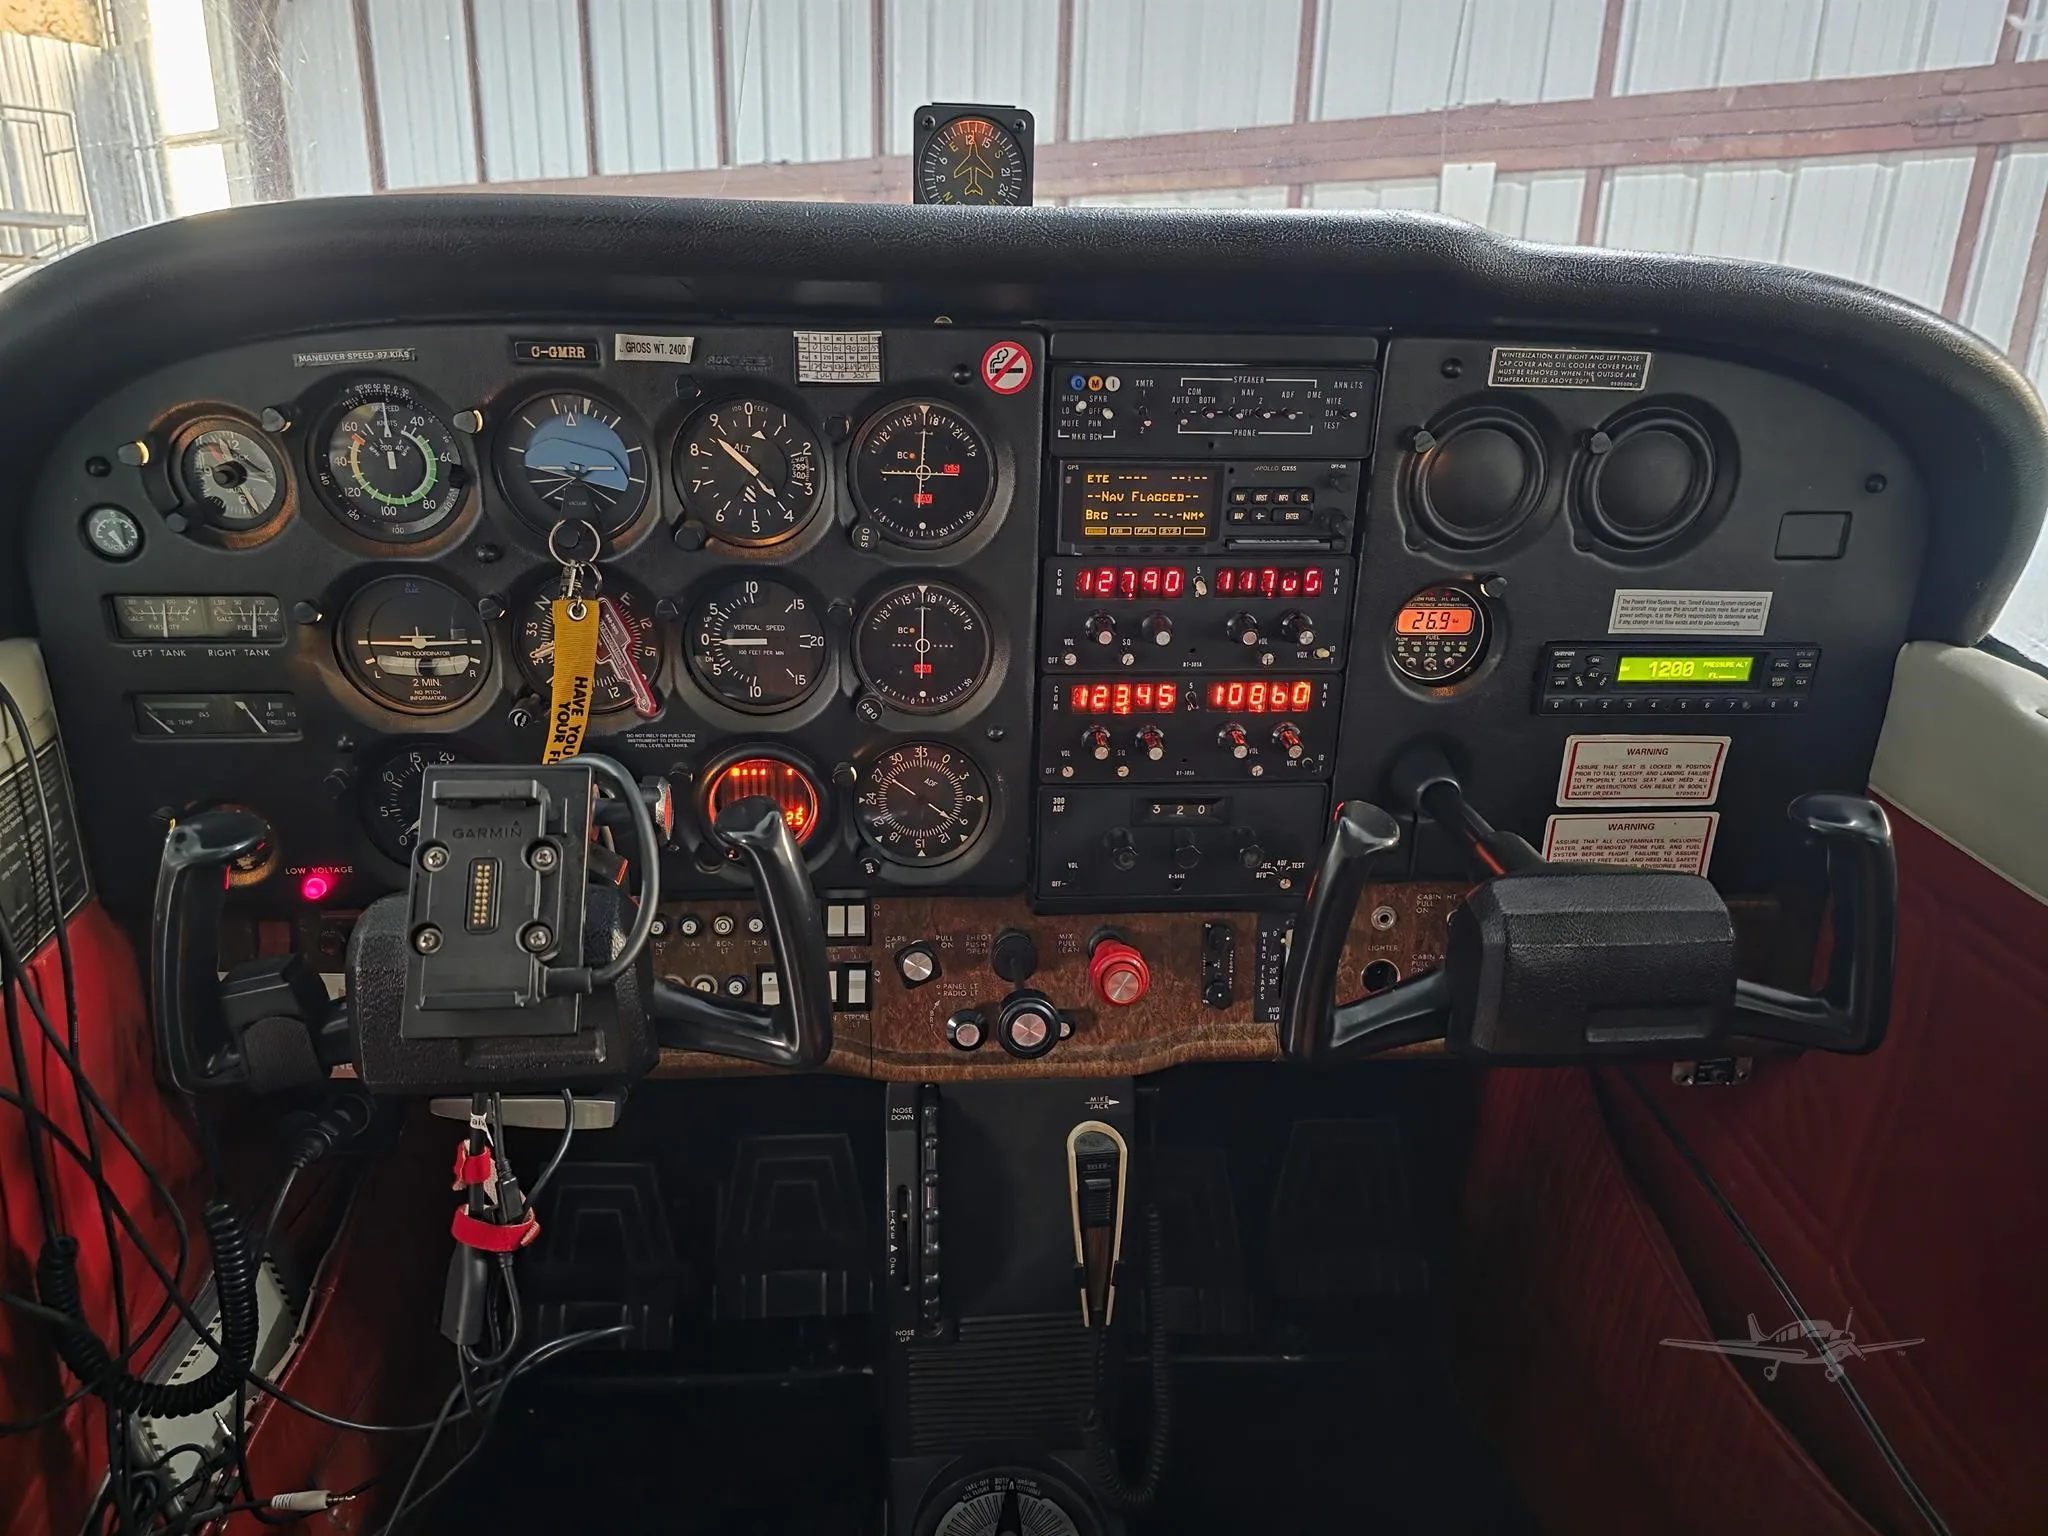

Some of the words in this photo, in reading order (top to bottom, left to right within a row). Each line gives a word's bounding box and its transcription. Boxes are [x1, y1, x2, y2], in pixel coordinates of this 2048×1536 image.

[949, 142, 958, 152] E
[995, 150, 1003, 158] S
[532, 346, 585, 358] C-GMRR
[626, 342, 651, 353] GROSS
[653, 342, 667, 354] WT.
[669, 344, 686, 355] 2400
[299, 354, 345, 362] MANEUVER
[744, 402, 753, 415] 0
[410, 417, 424, 426] 40
[710, 414, 718, 426] 9
[342, 422, 357, 432] 160
[690, 443, 699, 456] 8
[734, 443, 751, 453] ALT
[1087, 475, 1109, 484] ETE
[345, 488, 361, 497] 120
[423, 501, 436, 509] 80
[381, 507, 397, 516] 100
[784, 510, 794, 522] 4
[752, 521, 760, 532] 5
[861, 528, 869, 548] OBS
[1412, 612, 1450, 630] 26.9
[810, 636, 824, 646] 20
[1648, 661, 1695, 677] 1200
[422, 678, 441, 686] MIN.
[571, 676, 588, 716] HAVE
[554, 703, 570, 742] YOUR
[563, 725, 582, 755] YOU
[1627, 748, 1668, 756] WARNING
[453, 828, 522, 839] GARMIN
